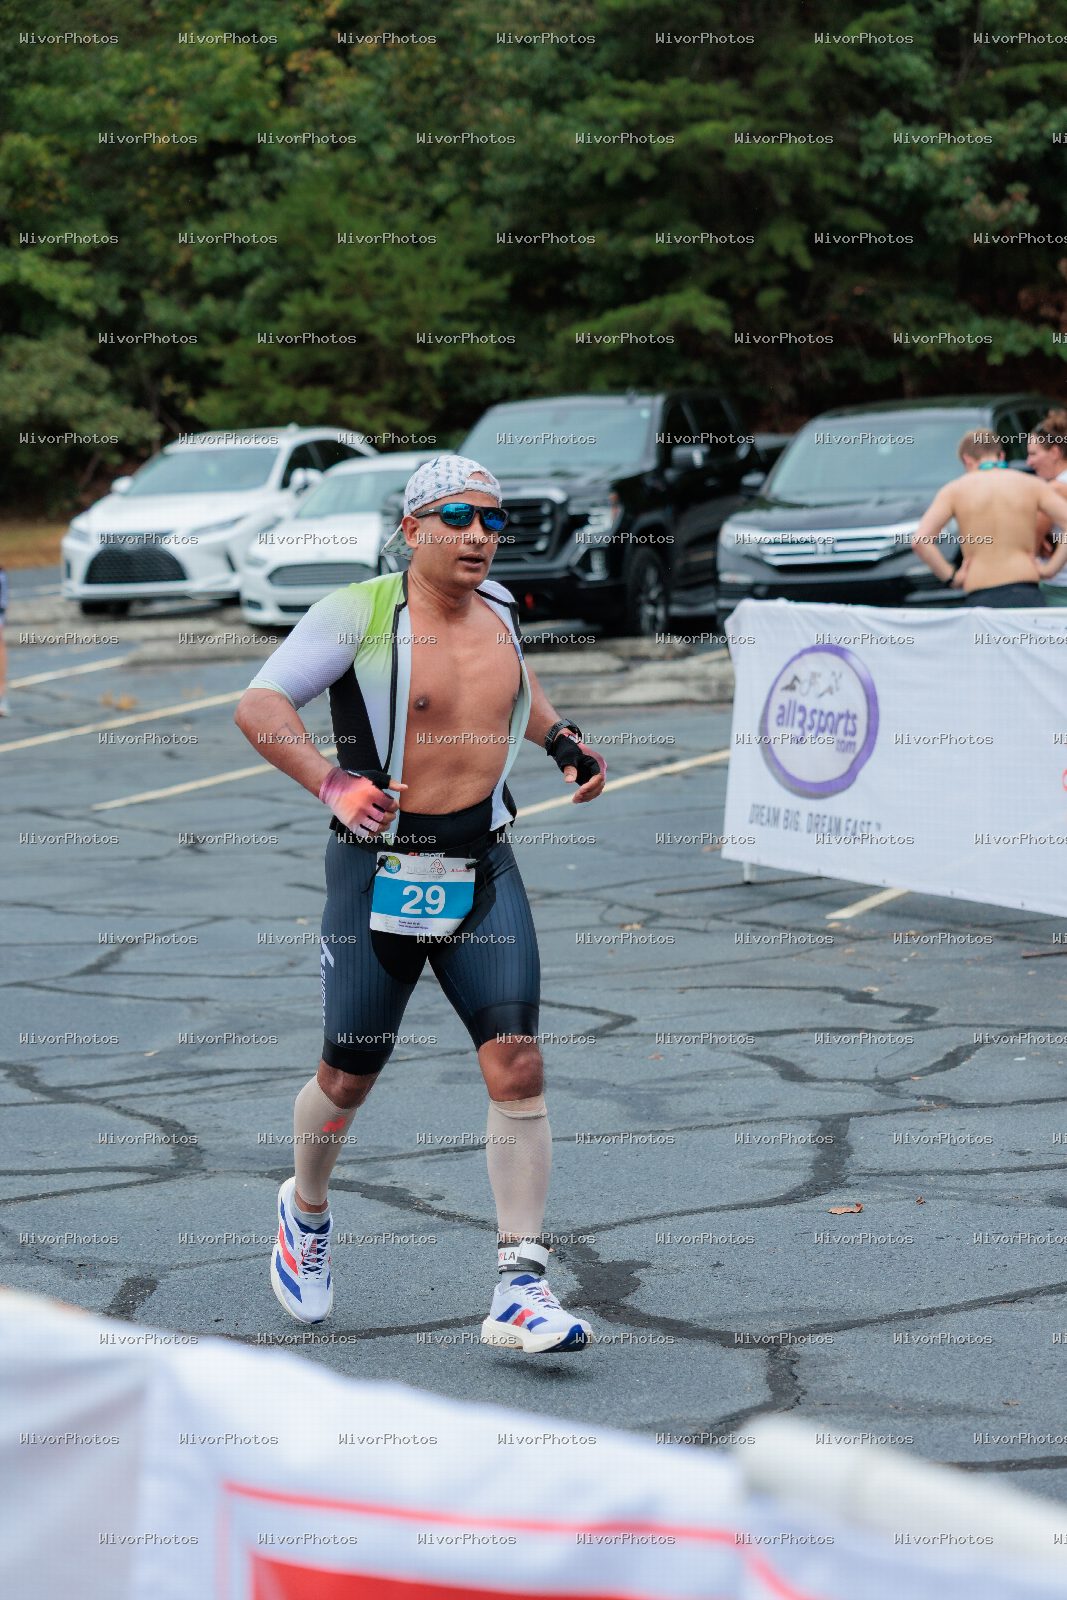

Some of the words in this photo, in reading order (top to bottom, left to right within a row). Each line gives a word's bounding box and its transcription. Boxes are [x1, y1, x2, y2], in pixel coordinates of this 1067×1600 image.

[748, 803, 780, 828] DREAM
[806, 812, 841, 835] DREAM
[400, 885, 446, 915] 29
